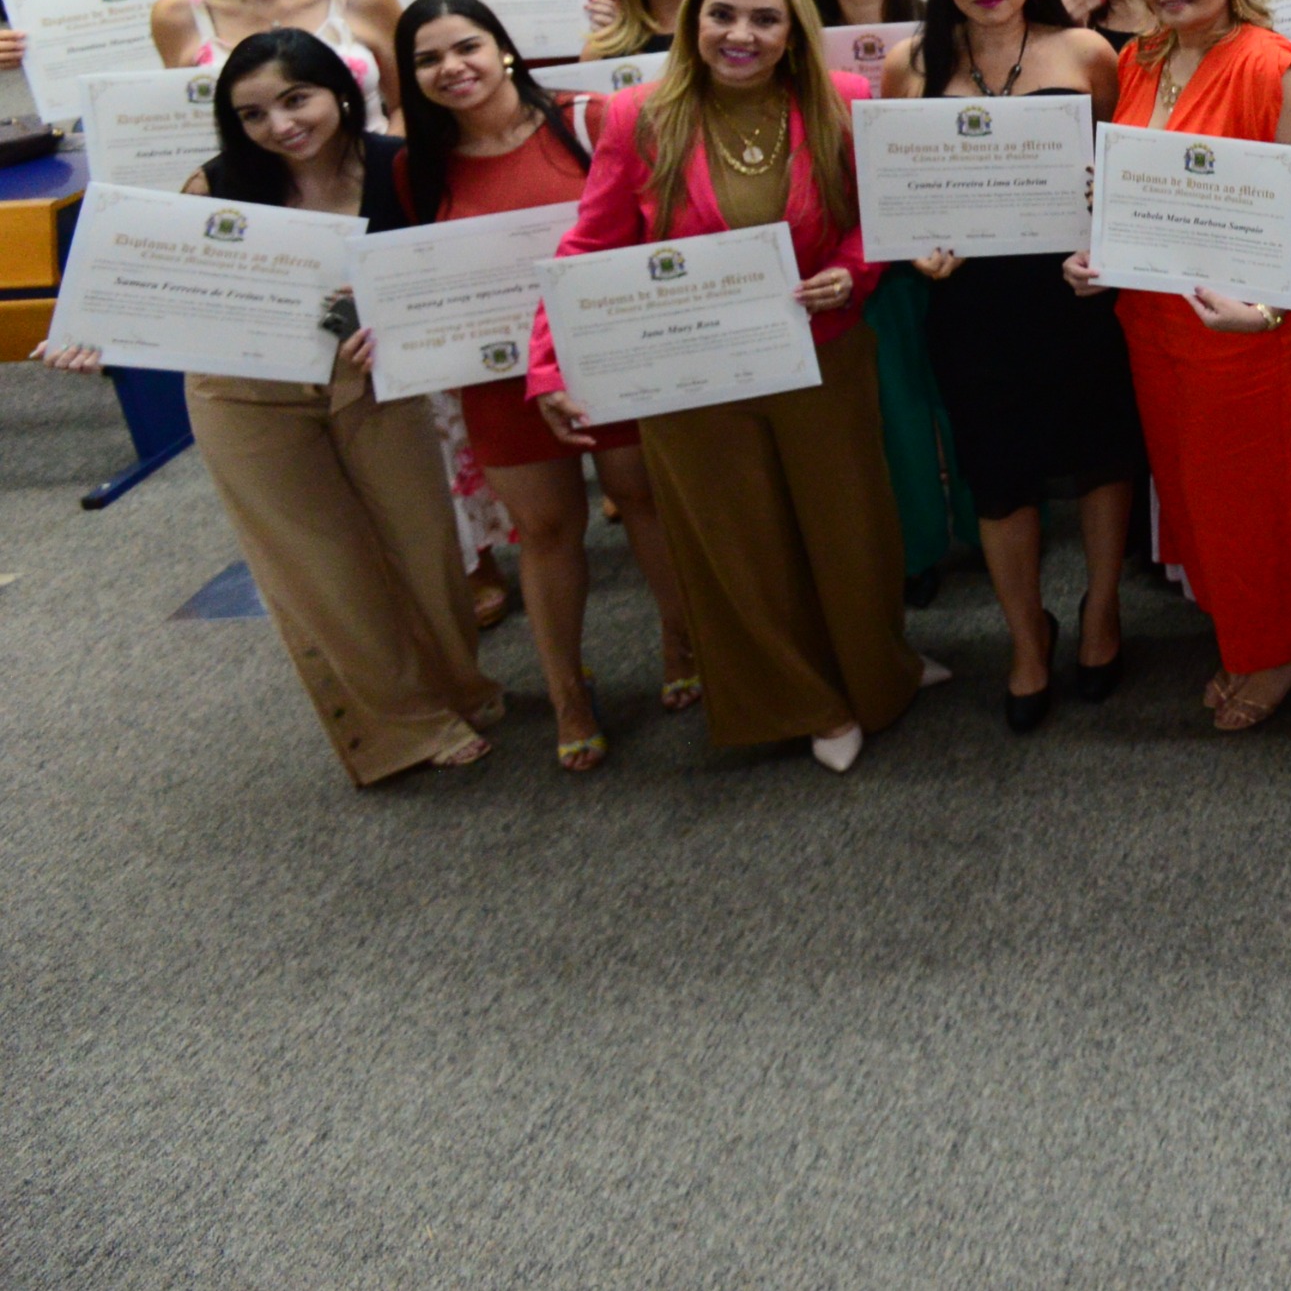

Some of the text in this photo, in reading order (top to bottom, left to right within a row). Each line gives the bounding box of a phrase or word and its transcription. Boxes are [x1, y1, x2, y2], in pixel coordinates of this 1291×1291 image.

[887, 138, 1063, 155] Diploma de Honra ao Mérito
[986, 178, 1011, 188] Lima
[1121, 170, 1276, 200] Diploma de Honra ao Mérito
[1166, 214, 1191, 225] Maria
[1193, 217, 1227, 229] Barbosa
[1229, 221, 1264, 236] Sampaio
[113, 232, 177, 253] Diploma
[181, 243, 197, 254] de
[202, 244, 247, 261] Honra
[272, 254, 322, 271] Mérito
[579, 270, 766, 311] Diploma de Honra ao Mérito
[668, 323, 694, 336] Mary
[696, 318, 721, 331] Rosa
